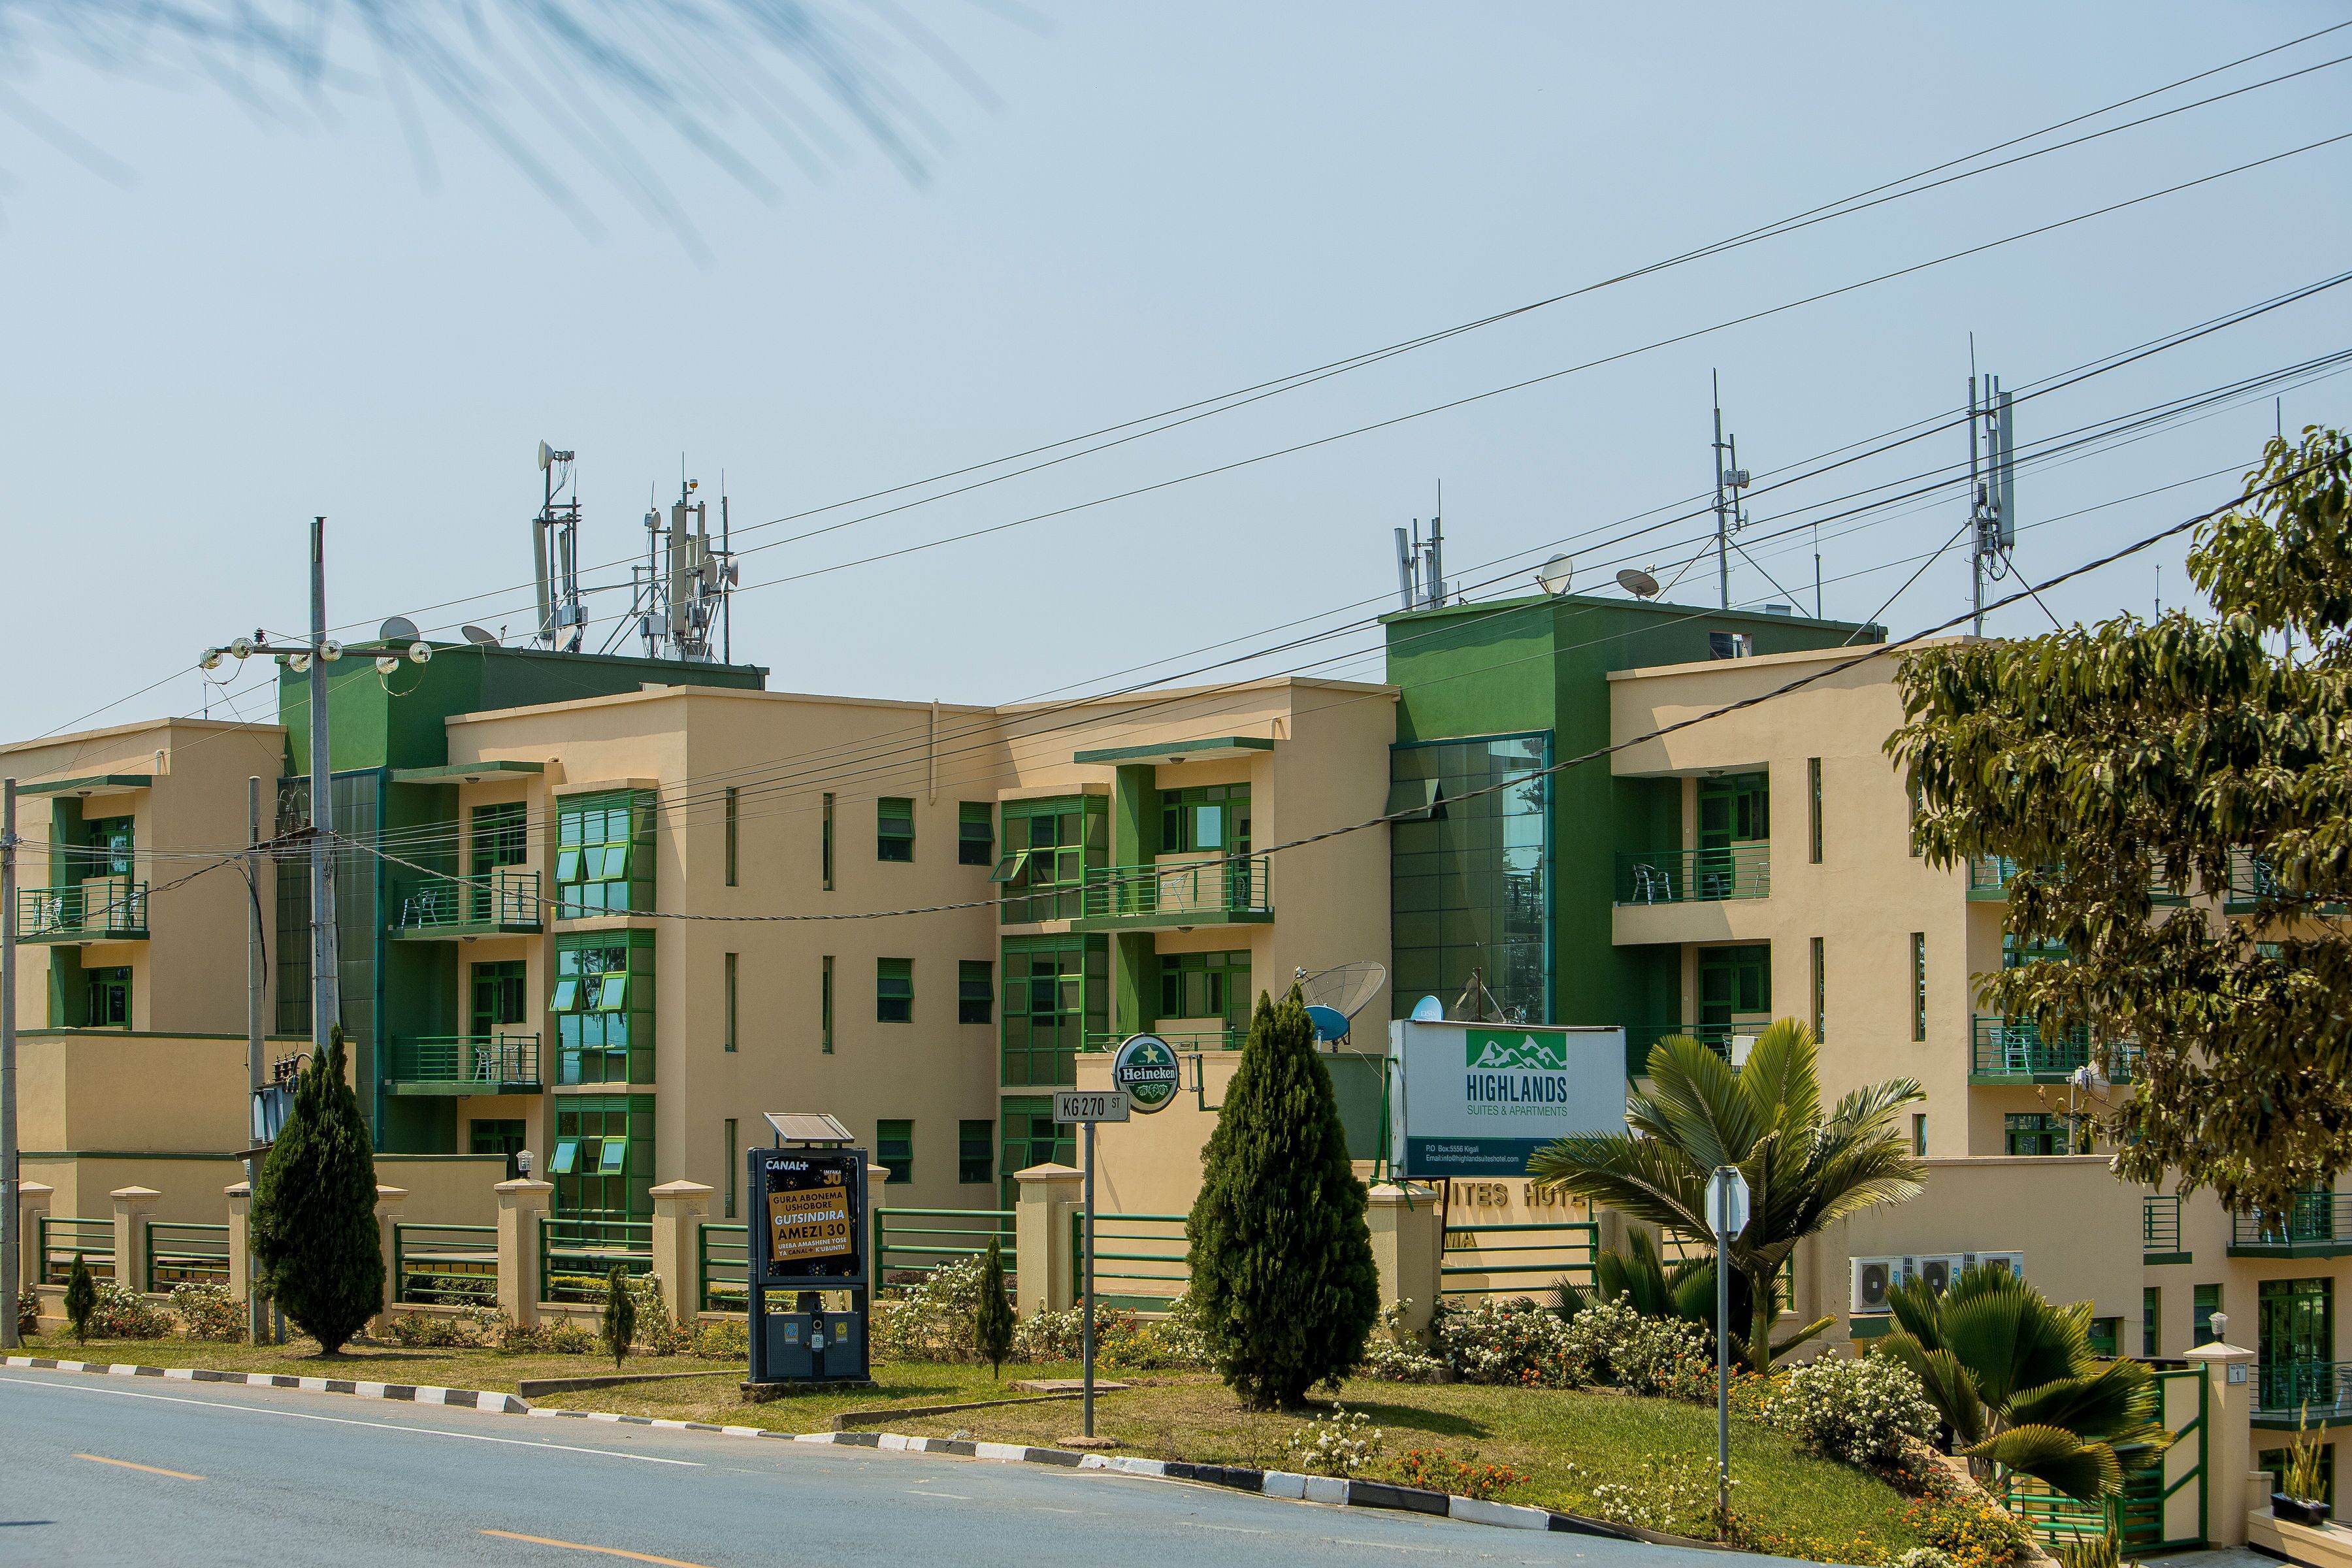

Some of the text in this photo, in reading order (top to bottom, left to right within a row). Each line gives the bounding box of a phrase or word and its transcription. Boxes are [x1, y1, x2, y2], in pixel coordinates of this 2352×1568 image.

[1123, 1067, 1175, 1081] Heineken
[1467, 1074, 1567, 1103] HIGHLANDS
[1063, 1097, 1120, 1117] KG 270 ST
[1467, 1104, 1567, 1117] SUITES & APARTMENTS
[1464, 1145, 1479, 1154] Kigali
[766, 1160, 809, 1170] CANAL+
[773, 1191, 843, 1204] GURA ABONEMA
[785, 1201, 832, 1211] USHOBORE
[775, 1209, 845, 1226] GUTSINDIRA
[777, 1222, 846, 1241] AMEZI 30
[798, 1239, 830, 1247] AMASHENE
[815, 1244, 845, 1252] K'UBUNTU
[2236, 1370, 2239, 1380] 1
